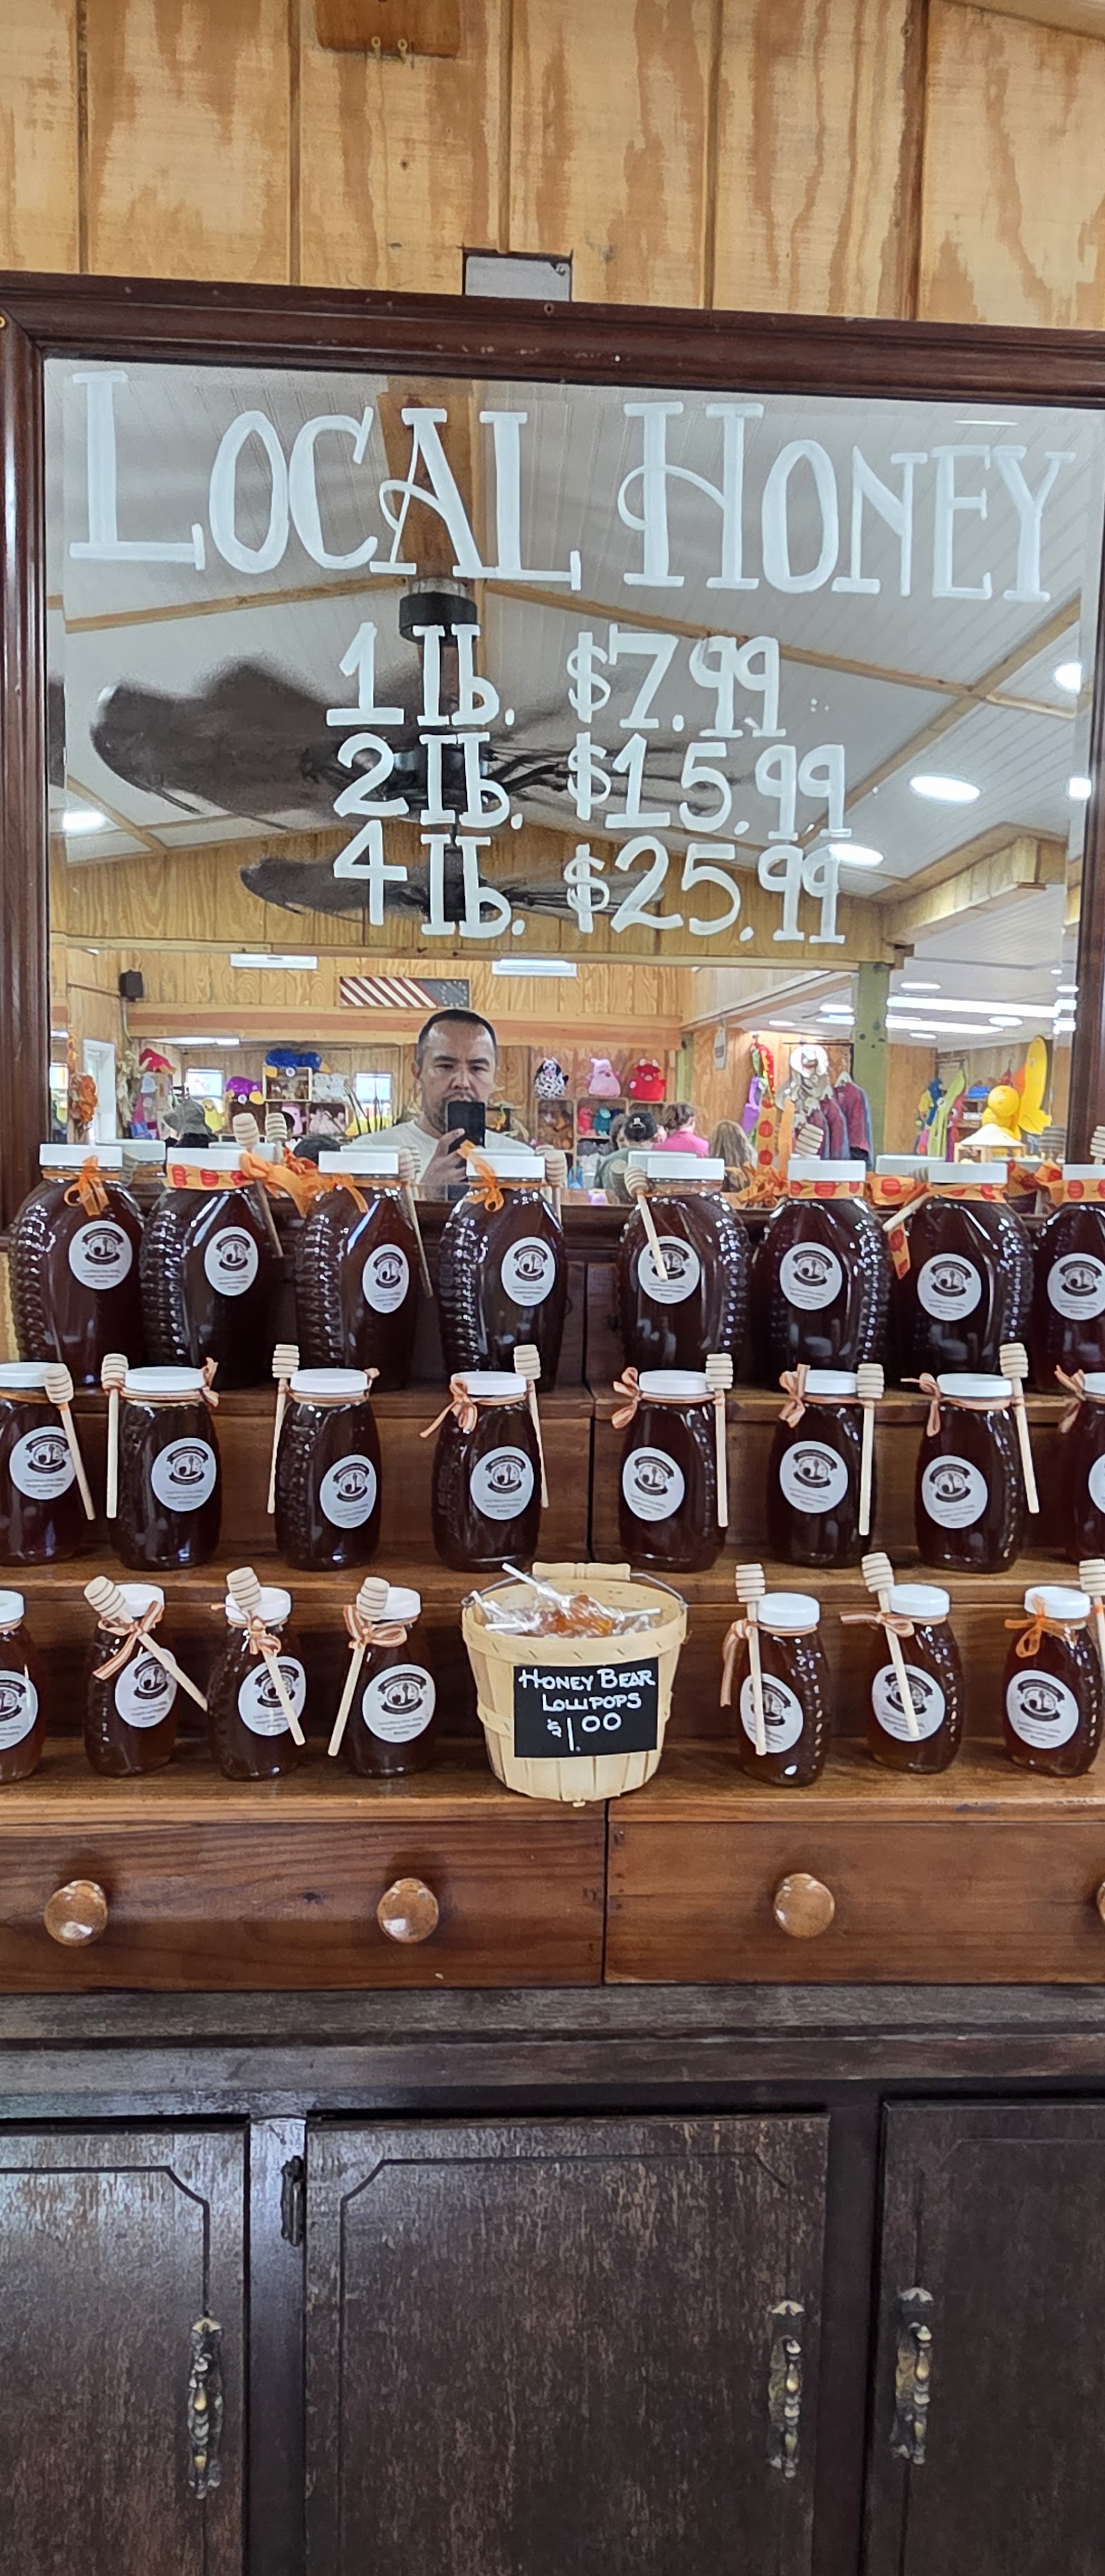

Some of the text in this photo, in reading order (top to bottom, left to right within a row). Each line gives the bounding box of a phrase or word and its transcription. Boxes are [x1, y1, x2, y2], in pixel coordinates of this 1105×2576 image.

[69, 370, 1077, 603] LOCAL HONEY
[326, 622, 405, 727] 1
[566, 629, 789, 738] $7.99
[333, 733, 410, 818] 2
[566, 731, 852, 839] $15.99
[333, 820, 407, 927] 4
[564, 836, 847, 945] $25.99
[518, 1668, 656, 1691] HONEY BEAR
[541, 1693, 642, 1712] LOLLIPOPS
[546, 1712, 622, 1752] $1.00
